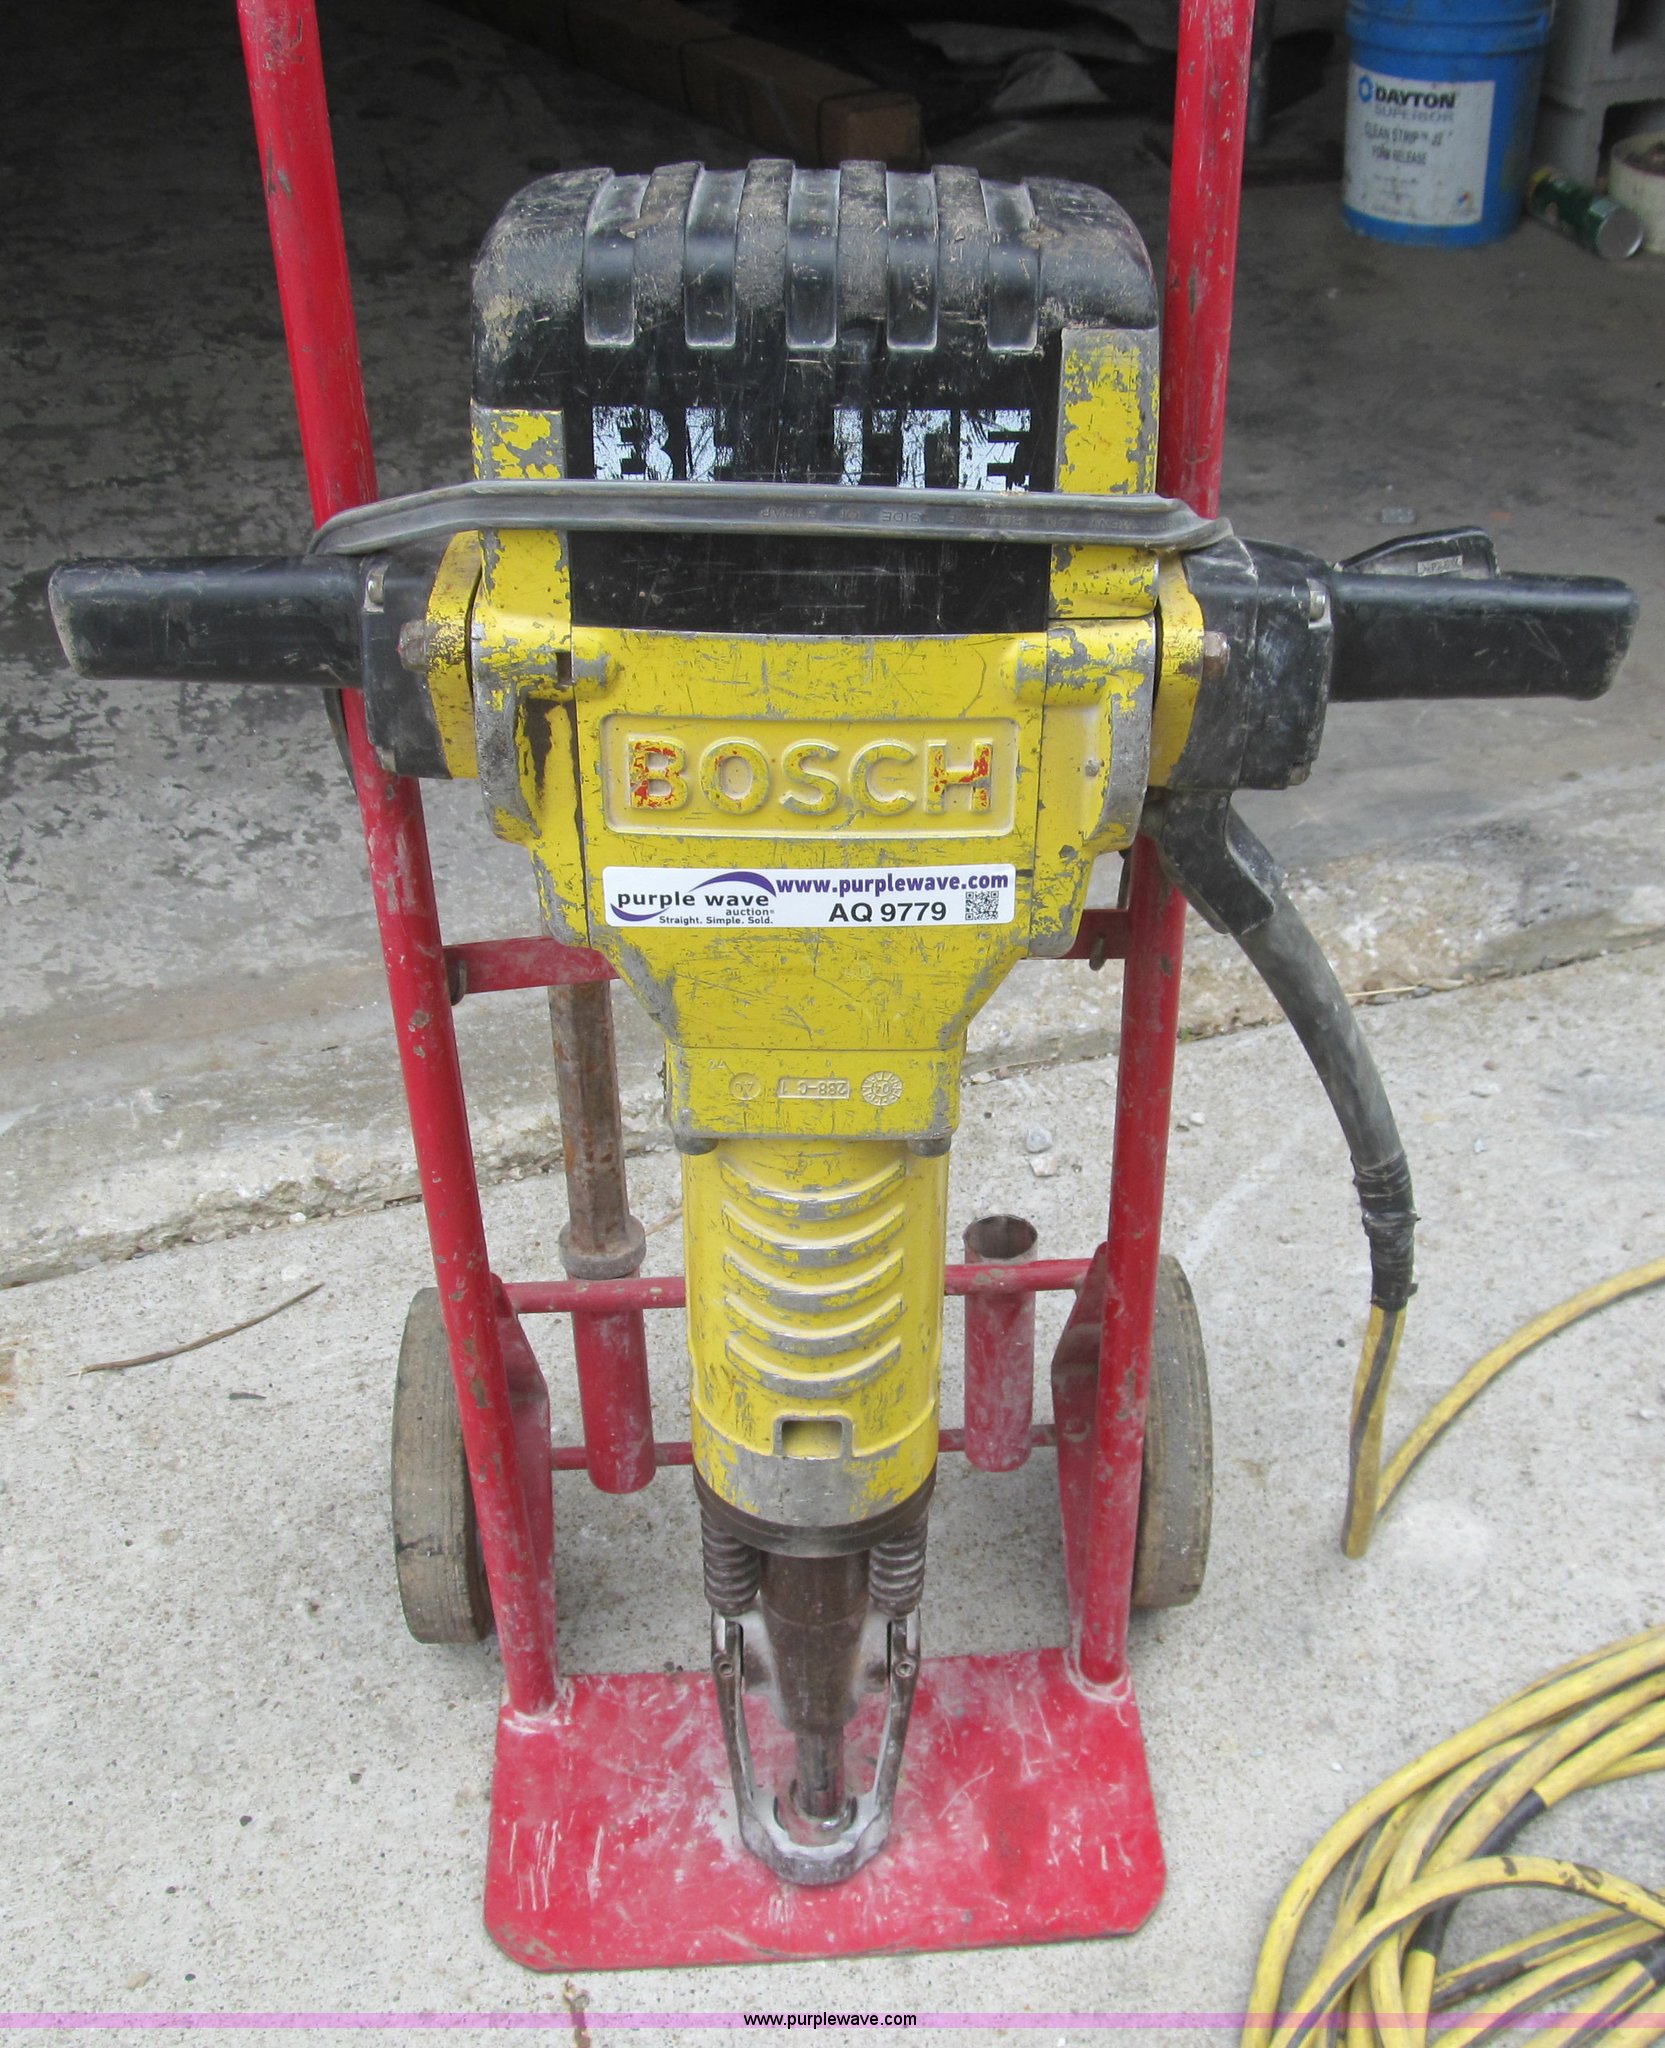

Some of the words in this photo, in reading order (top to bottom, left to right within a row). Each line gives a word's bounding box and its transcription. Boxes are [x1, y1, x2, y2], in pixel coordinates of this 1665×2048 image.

[1375, 85, 1456, 109] DAYTON
[1374, 104, 1455, 123] SUPERIOR
[880, 510, 923, 523] SIDE
[627, 734, 994, 817] BOSCH
[775, 872, 1010, 898] www.purplewave.com
[617, 890, 697, 909] purple
[704, 892, 770, 907] wave
[658, 914, 704, 926] Straight.
[705, 914, 745, 926] Simple.
[747, 914, 775, 925] Sold.
[828, 902, 873, 923] AQ
[880, 901, 947, 923] 9779
